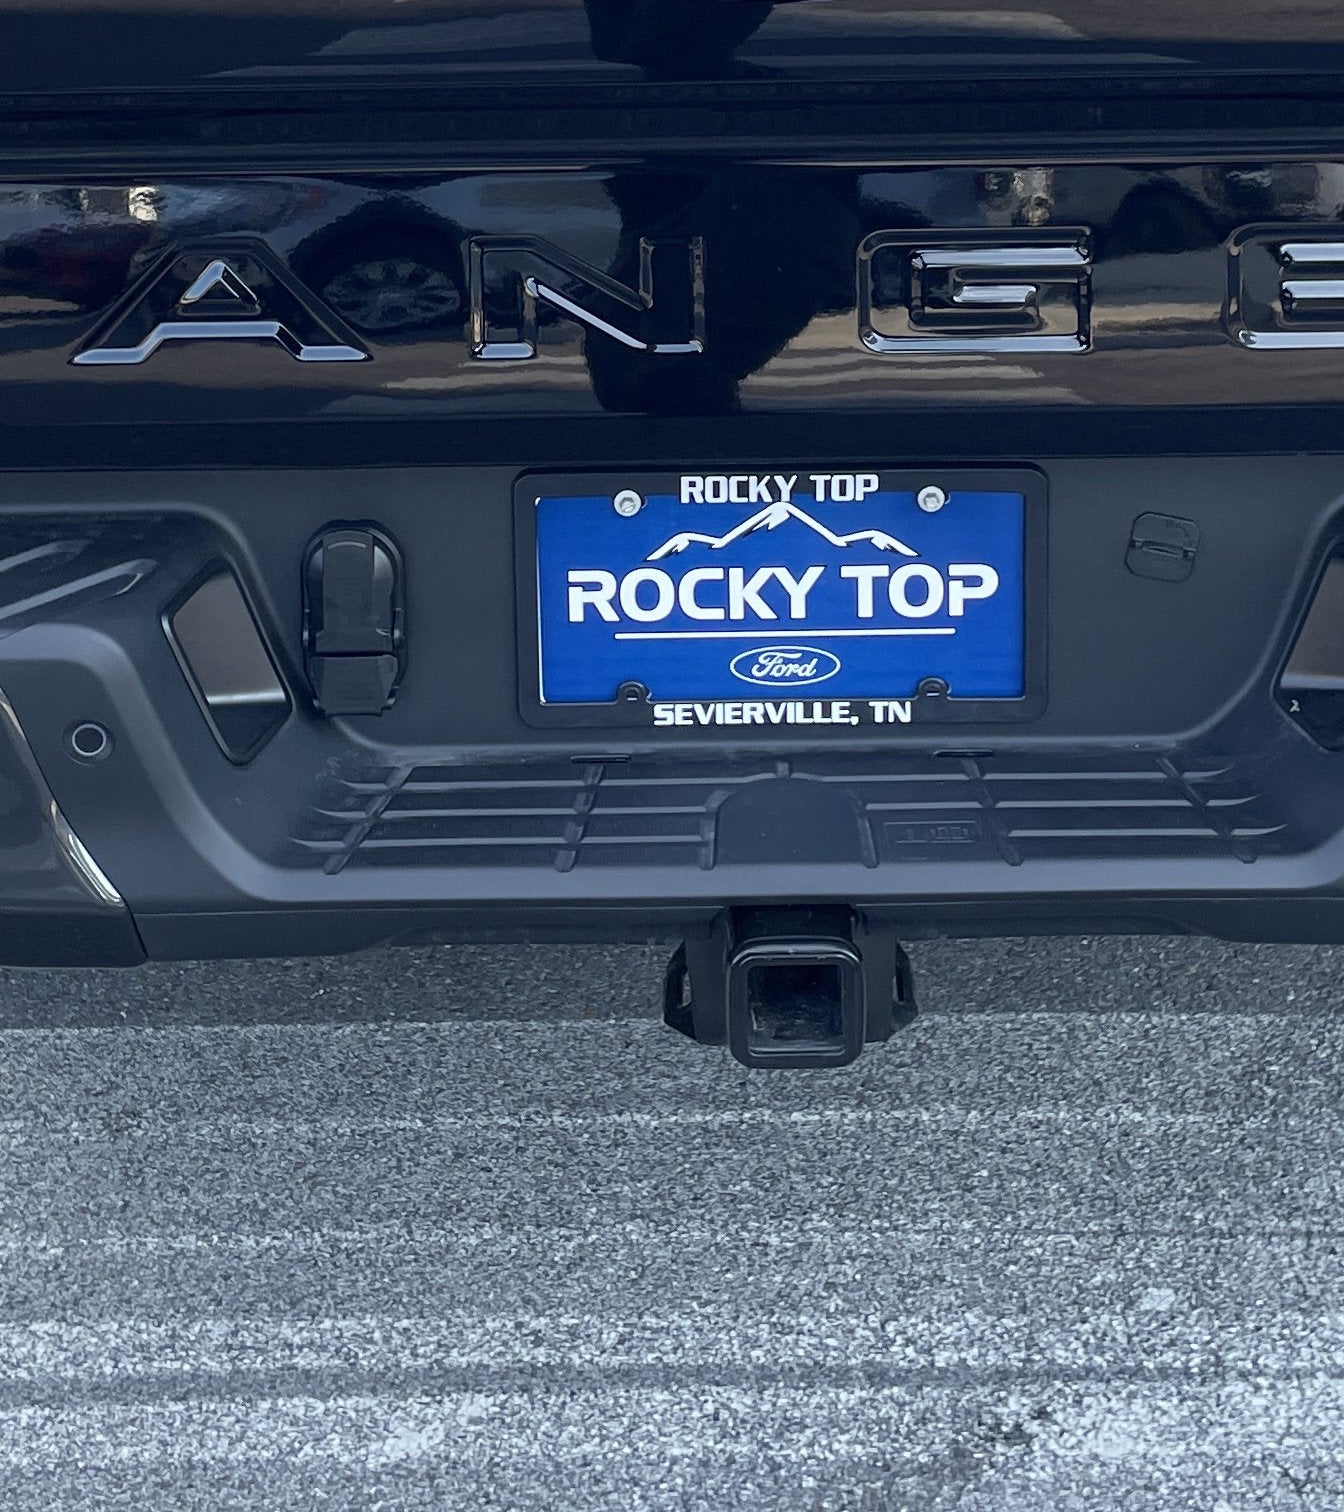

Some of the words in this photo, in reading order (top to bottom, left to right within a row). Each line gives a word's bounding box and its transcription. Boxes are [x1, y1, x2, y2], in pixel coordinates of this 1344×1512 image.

[679, 475, 797, 504] ROCKY
[809, 474, 879, 503] TOP
[567, 566, 825, 623] ROCKY
[840, 563, 999, 619] TOP
[751, 651, 817, 679] Ford
[653, 701, 859, 727] SEVIERVILLE,
[869, 700, 912, 725] TN
